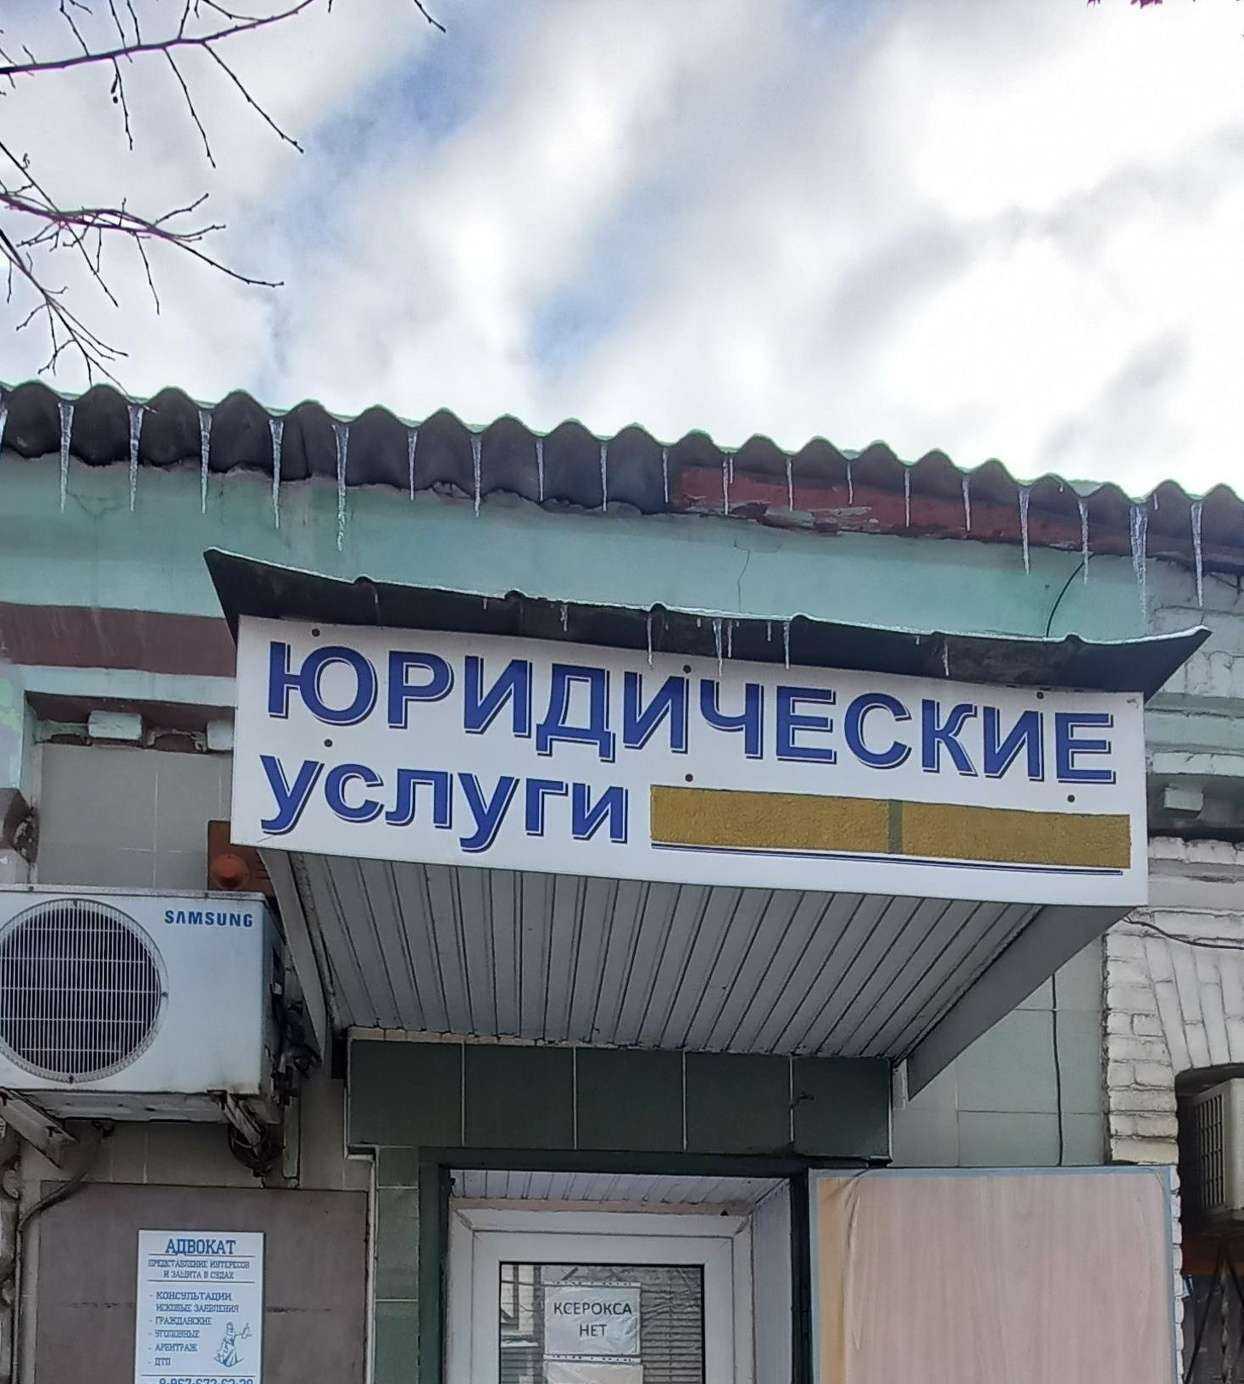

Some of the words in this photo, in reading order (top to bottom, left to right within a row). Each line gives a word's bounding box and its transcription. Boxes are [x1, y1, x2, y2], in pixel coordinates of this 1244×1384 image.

[266, 641, 1117, 785] ЮРИДИЧЕСКИЕ
[164, 909, 253, 927] SAMSUNG
[165, 1238, 236, 1255] АДВОКАТ
[171, 1271, 201, 1279] ЗАЩИТА
[210, 1271, 234, 1280] СУДАХ
[156, 1291, 232, 1301] КОНСУЛЬТАЦИИ
[553, 1302, 632, 1315] КСЕРОКСА
[155, 1316, 212, 1325] ГРАЖДАНСКИЕ
[579, 1323, 607, 1337] НЕТ
[155, 1343, 198, 1352] АРБИТРАЖ
[154, 1357, 171, 1366] ДТП
